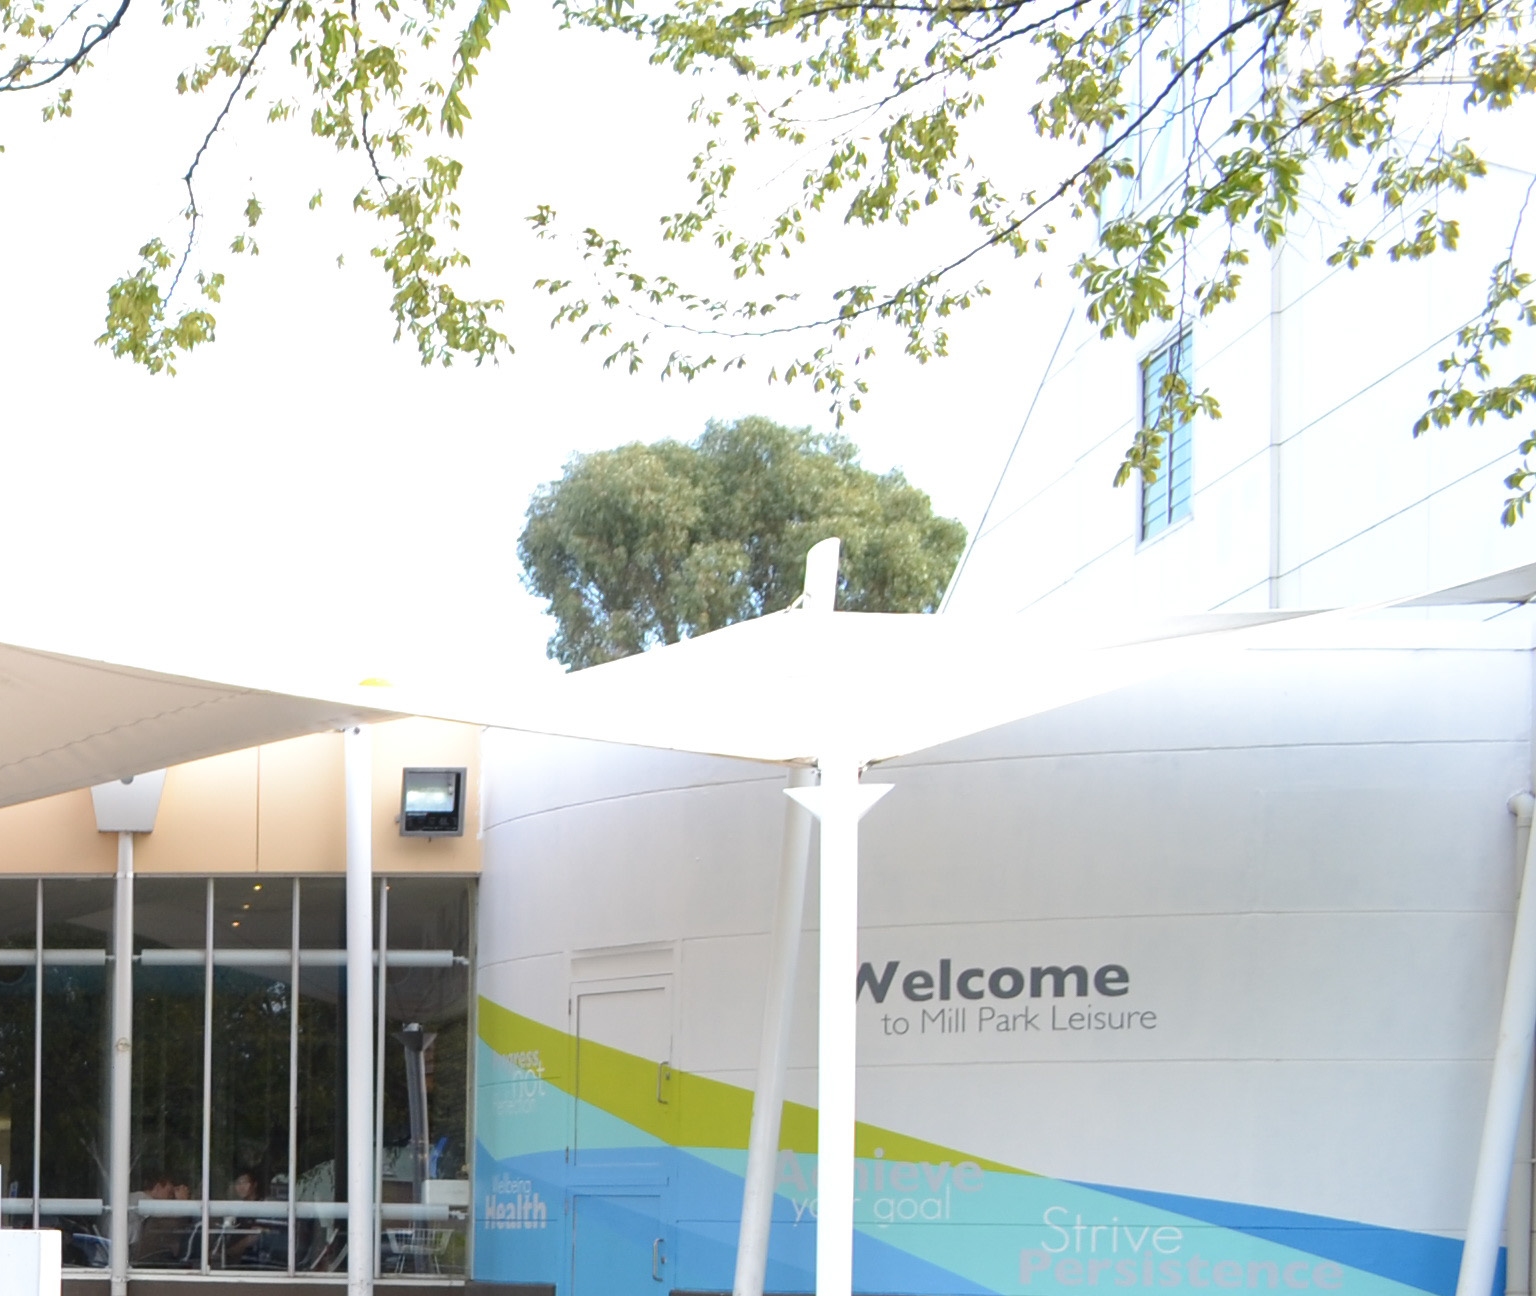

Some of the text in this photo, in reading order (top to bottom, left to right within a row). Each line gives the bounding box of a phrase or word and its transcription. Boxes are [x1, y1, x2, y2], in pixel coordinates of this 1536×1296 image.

[856, 958, 1130, 1004] Welcome
[881, 1004, 1157, 1035] to Mill Park Leisure
[774, 1147, 985, 1193] Aieve
[485, 1192, 547, 1229] Health
[873, 1183, 951, 1228] goal
[1041, 1205, 1183, 1254] Strive
[1019, 1248, 1344, 1290] Persistence
